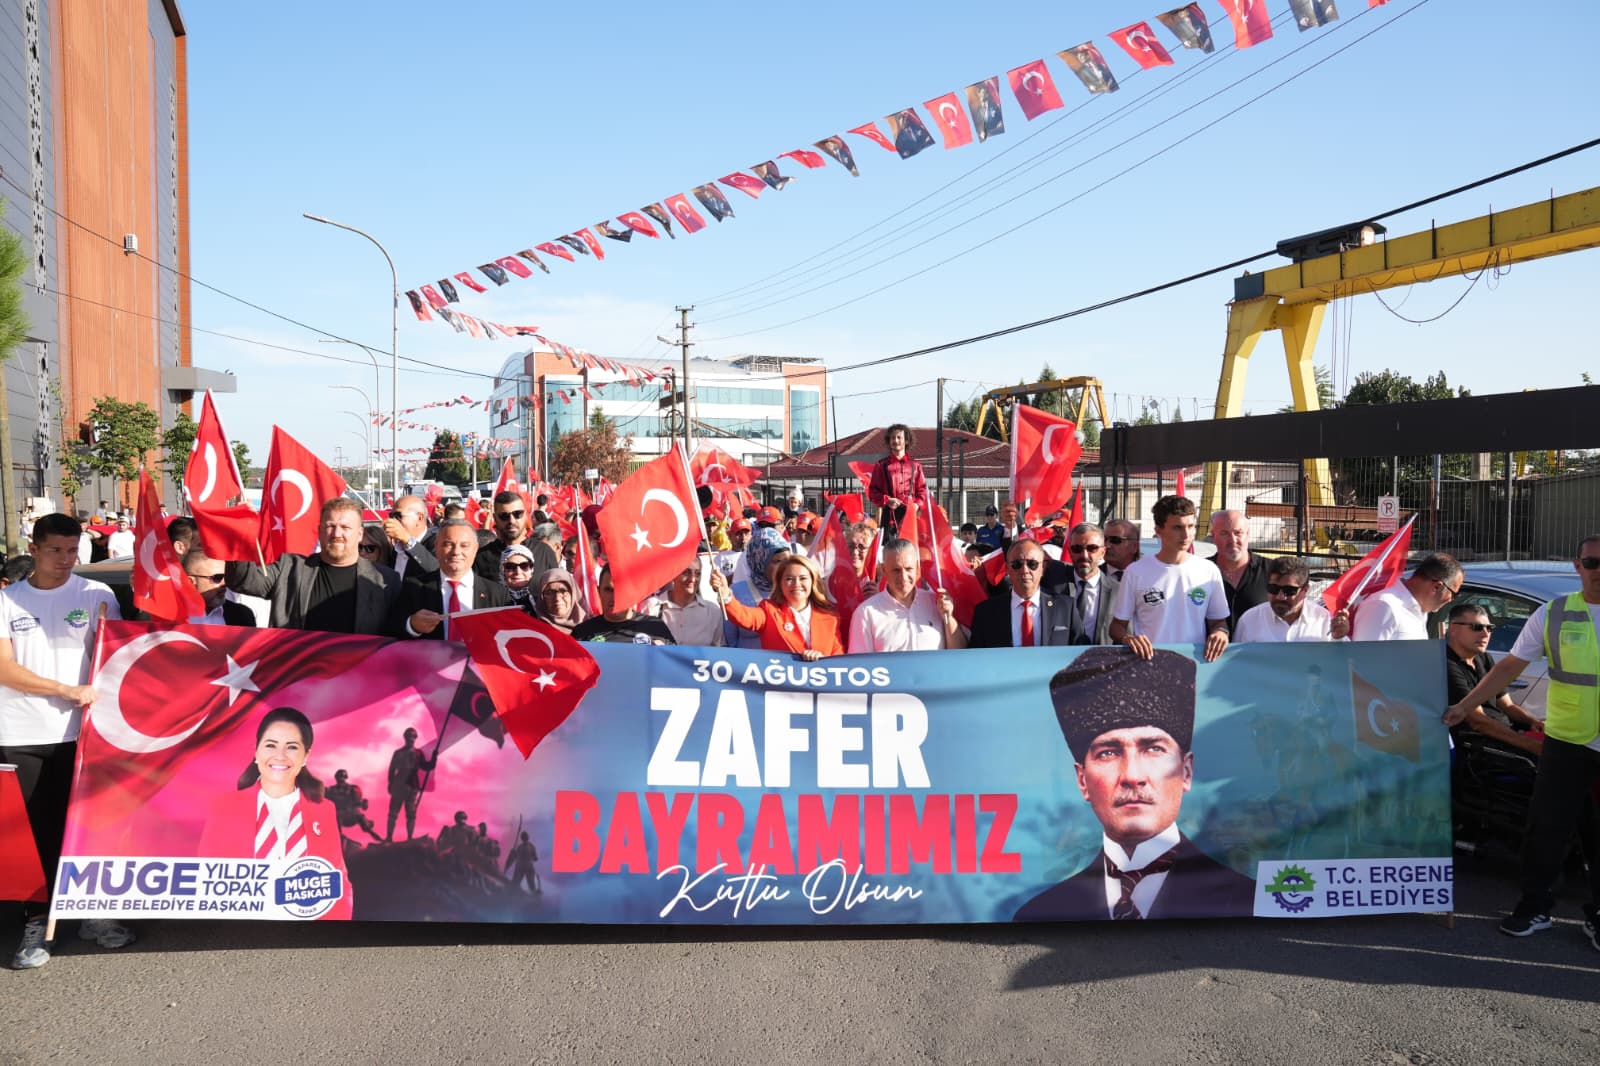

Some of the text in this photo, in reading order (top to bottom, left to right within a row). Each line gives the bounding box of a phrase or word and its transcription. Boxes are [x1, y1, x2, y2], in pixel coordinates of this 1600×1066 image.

[693, 658, 891, 687] 30 AĞUSTOS
[647, 687, 931, 788] ZAFER
[551, 789, 1022, 876] BAYRAMIMIZ
[57, 860, 201, 897] MÜGE
[205, 862, 271, 880] YILDIZ
[1325, 865, 1454, 885] T.C. ERGENE
[202, 880, 268, 897] TOPAK
[655, 857, 924, 919] Kutlu Olsun
[55, 897, 265, 913] ERGENE BELEDİYE BAŞKANI
